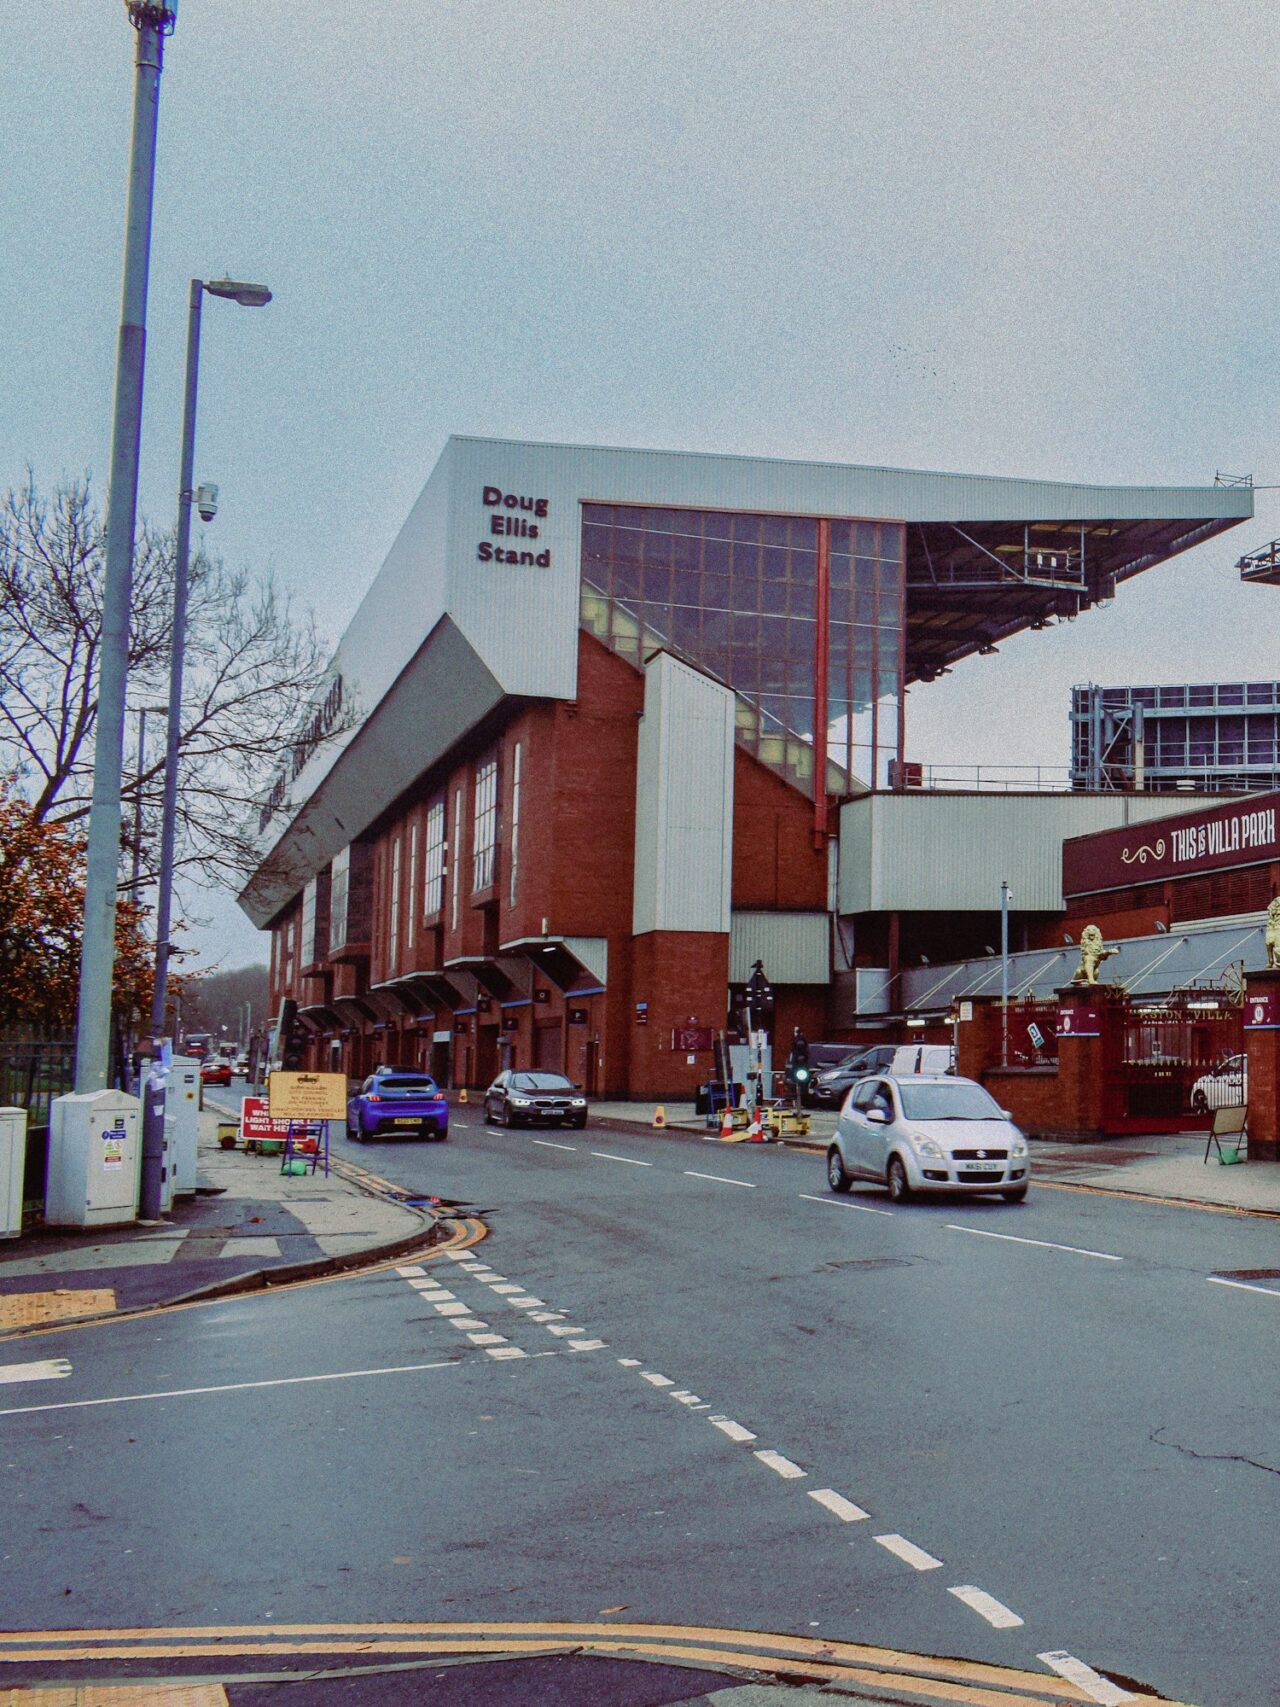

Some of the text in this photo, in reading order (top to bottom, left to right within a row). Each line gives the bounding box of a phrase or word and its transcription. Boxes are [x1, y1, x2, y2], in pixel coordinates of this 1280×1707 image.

[483, 486, 549, 517] Doug
[491, 514, 539, 539] Ellis
[478, 541, 551, 568] Stand
[1171, 808, 1276, 862] THIS IS VILLA PARK
[1193, 1010, 1232, 1020] VILLA
